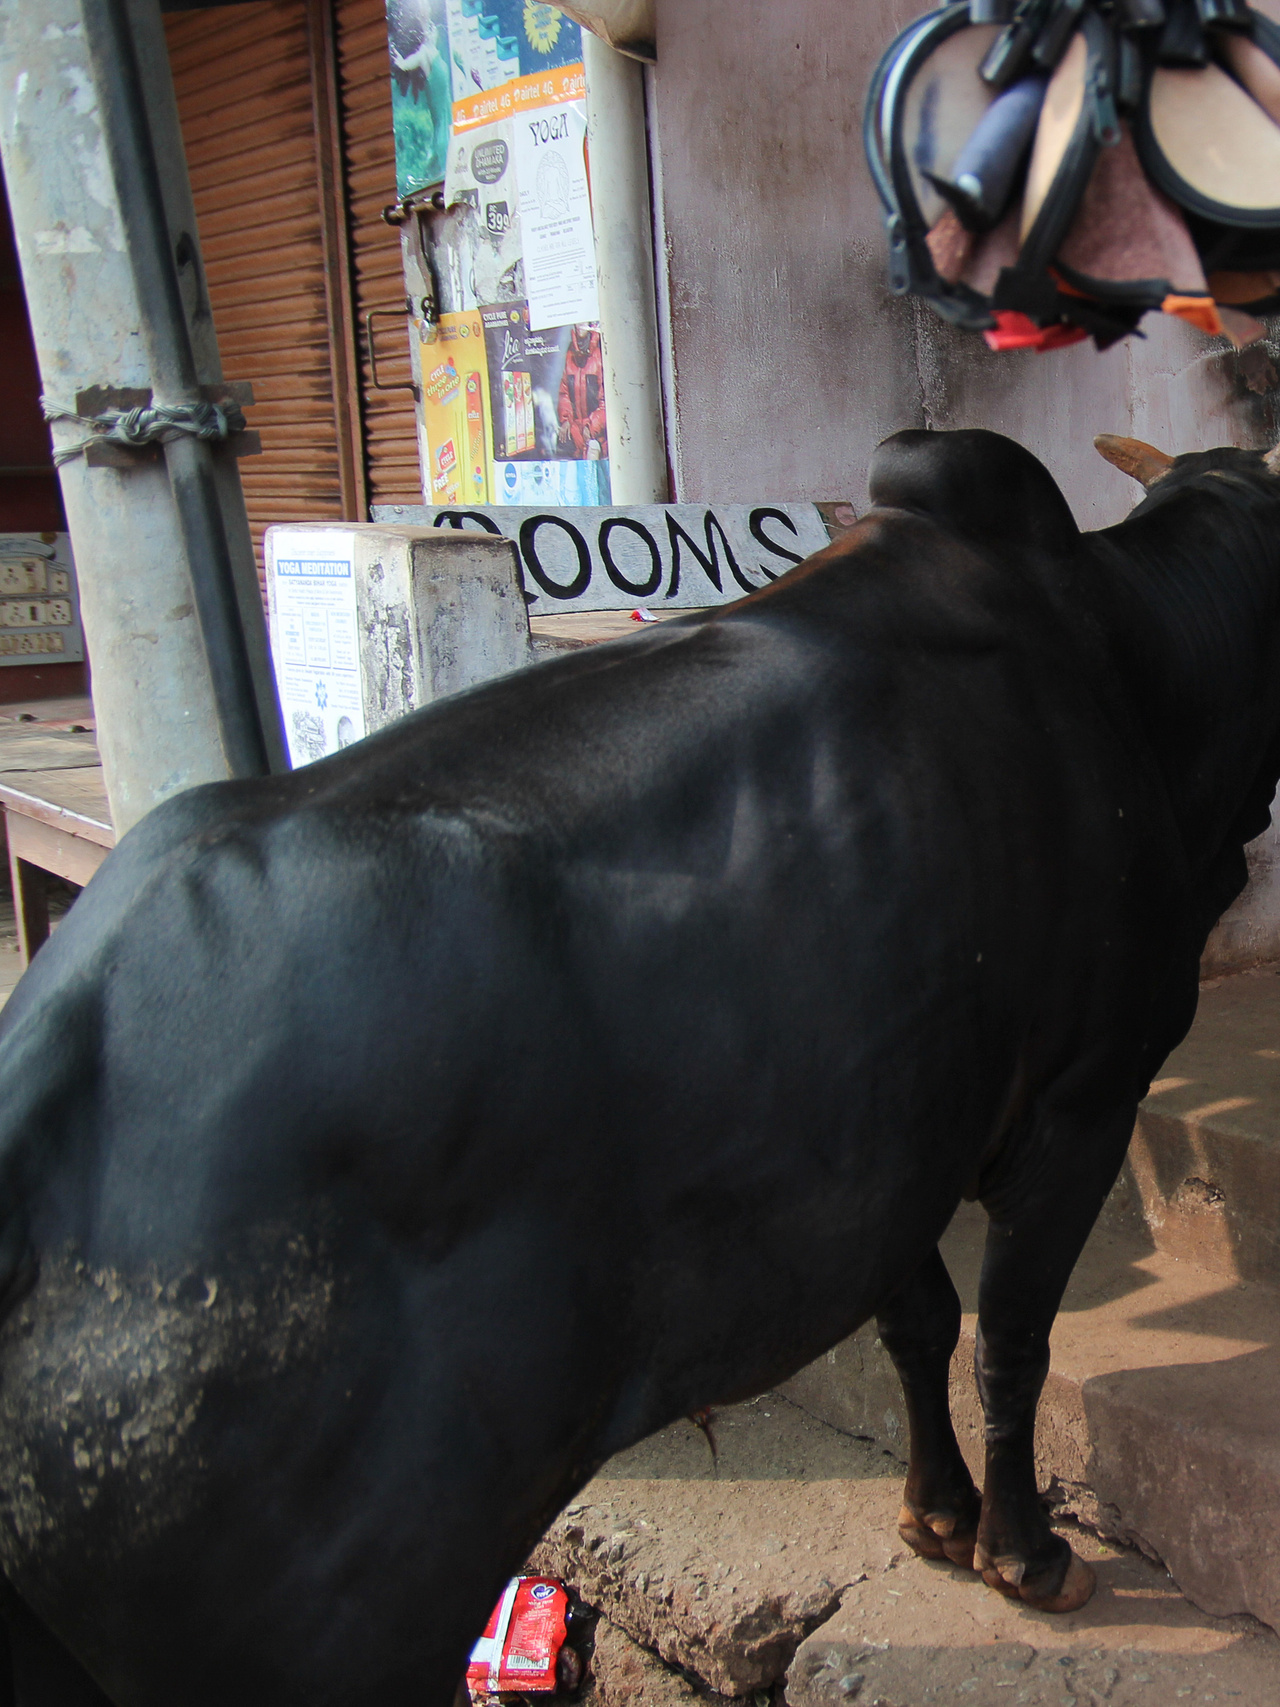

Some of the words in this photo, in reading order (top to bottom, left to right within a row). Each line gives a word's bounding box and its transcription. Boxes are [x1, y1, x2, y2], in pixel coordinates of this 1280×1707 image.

[480, 98, 499, 116] airtel
[500, 93, 511, 108] 4G
[521, 83, 540, 100] airtel
[542, 80, 554, 95] 4G
[569, 73, 586, 90] airt
[529, 112, 569, 146] YOGA
[488, 212, 509, 231] 399
[427, 375, 447, 397] three
[445, 376, 460, 392] one
[278, 561, 301, 575] YOGA
[301, 562, 350, 576] MEDITATION
